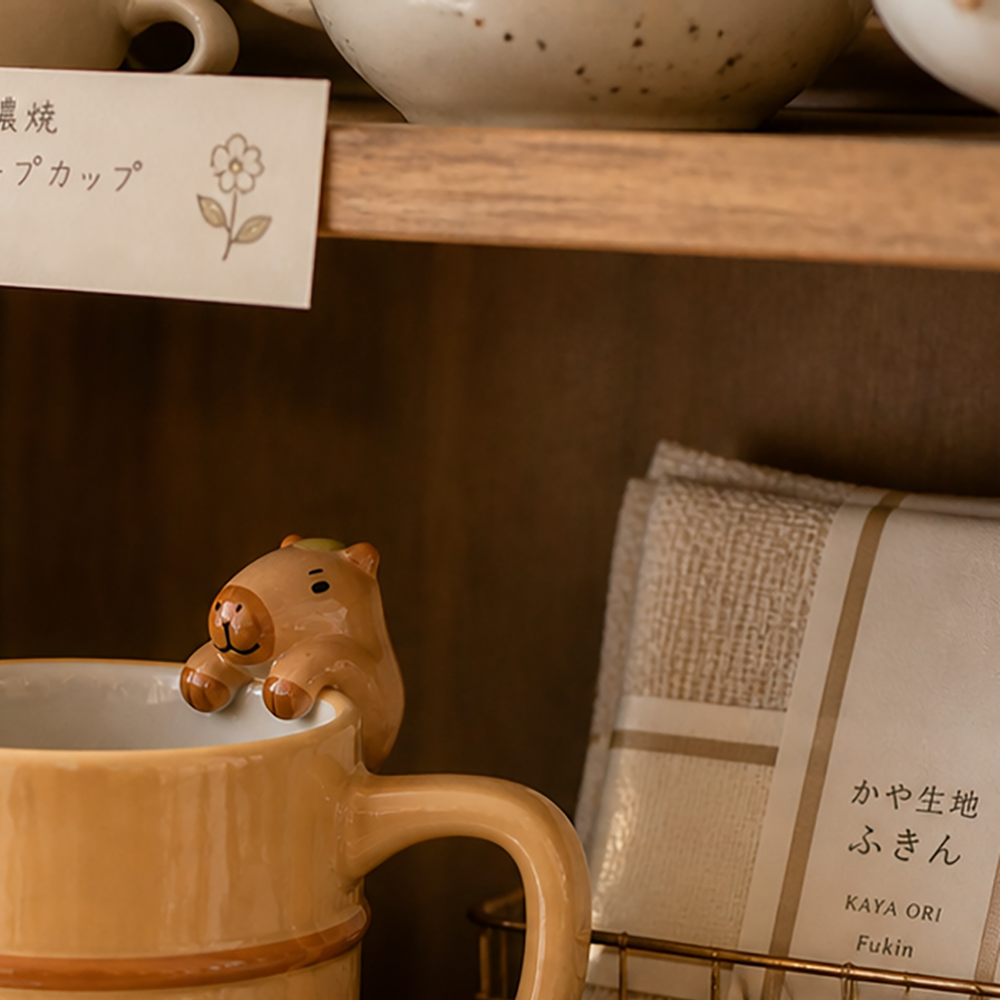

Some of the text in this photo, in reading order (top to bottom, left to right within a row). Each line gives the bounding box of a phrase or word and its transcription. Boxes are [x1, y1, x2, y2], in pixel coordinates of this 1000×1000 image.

[851, 779, 979, 819] かや生地
[848, 824, 962, 866] ふきん
[844, 894, 942, 923] KAYA ORI
[855, 934, 914, 959] Fukin
